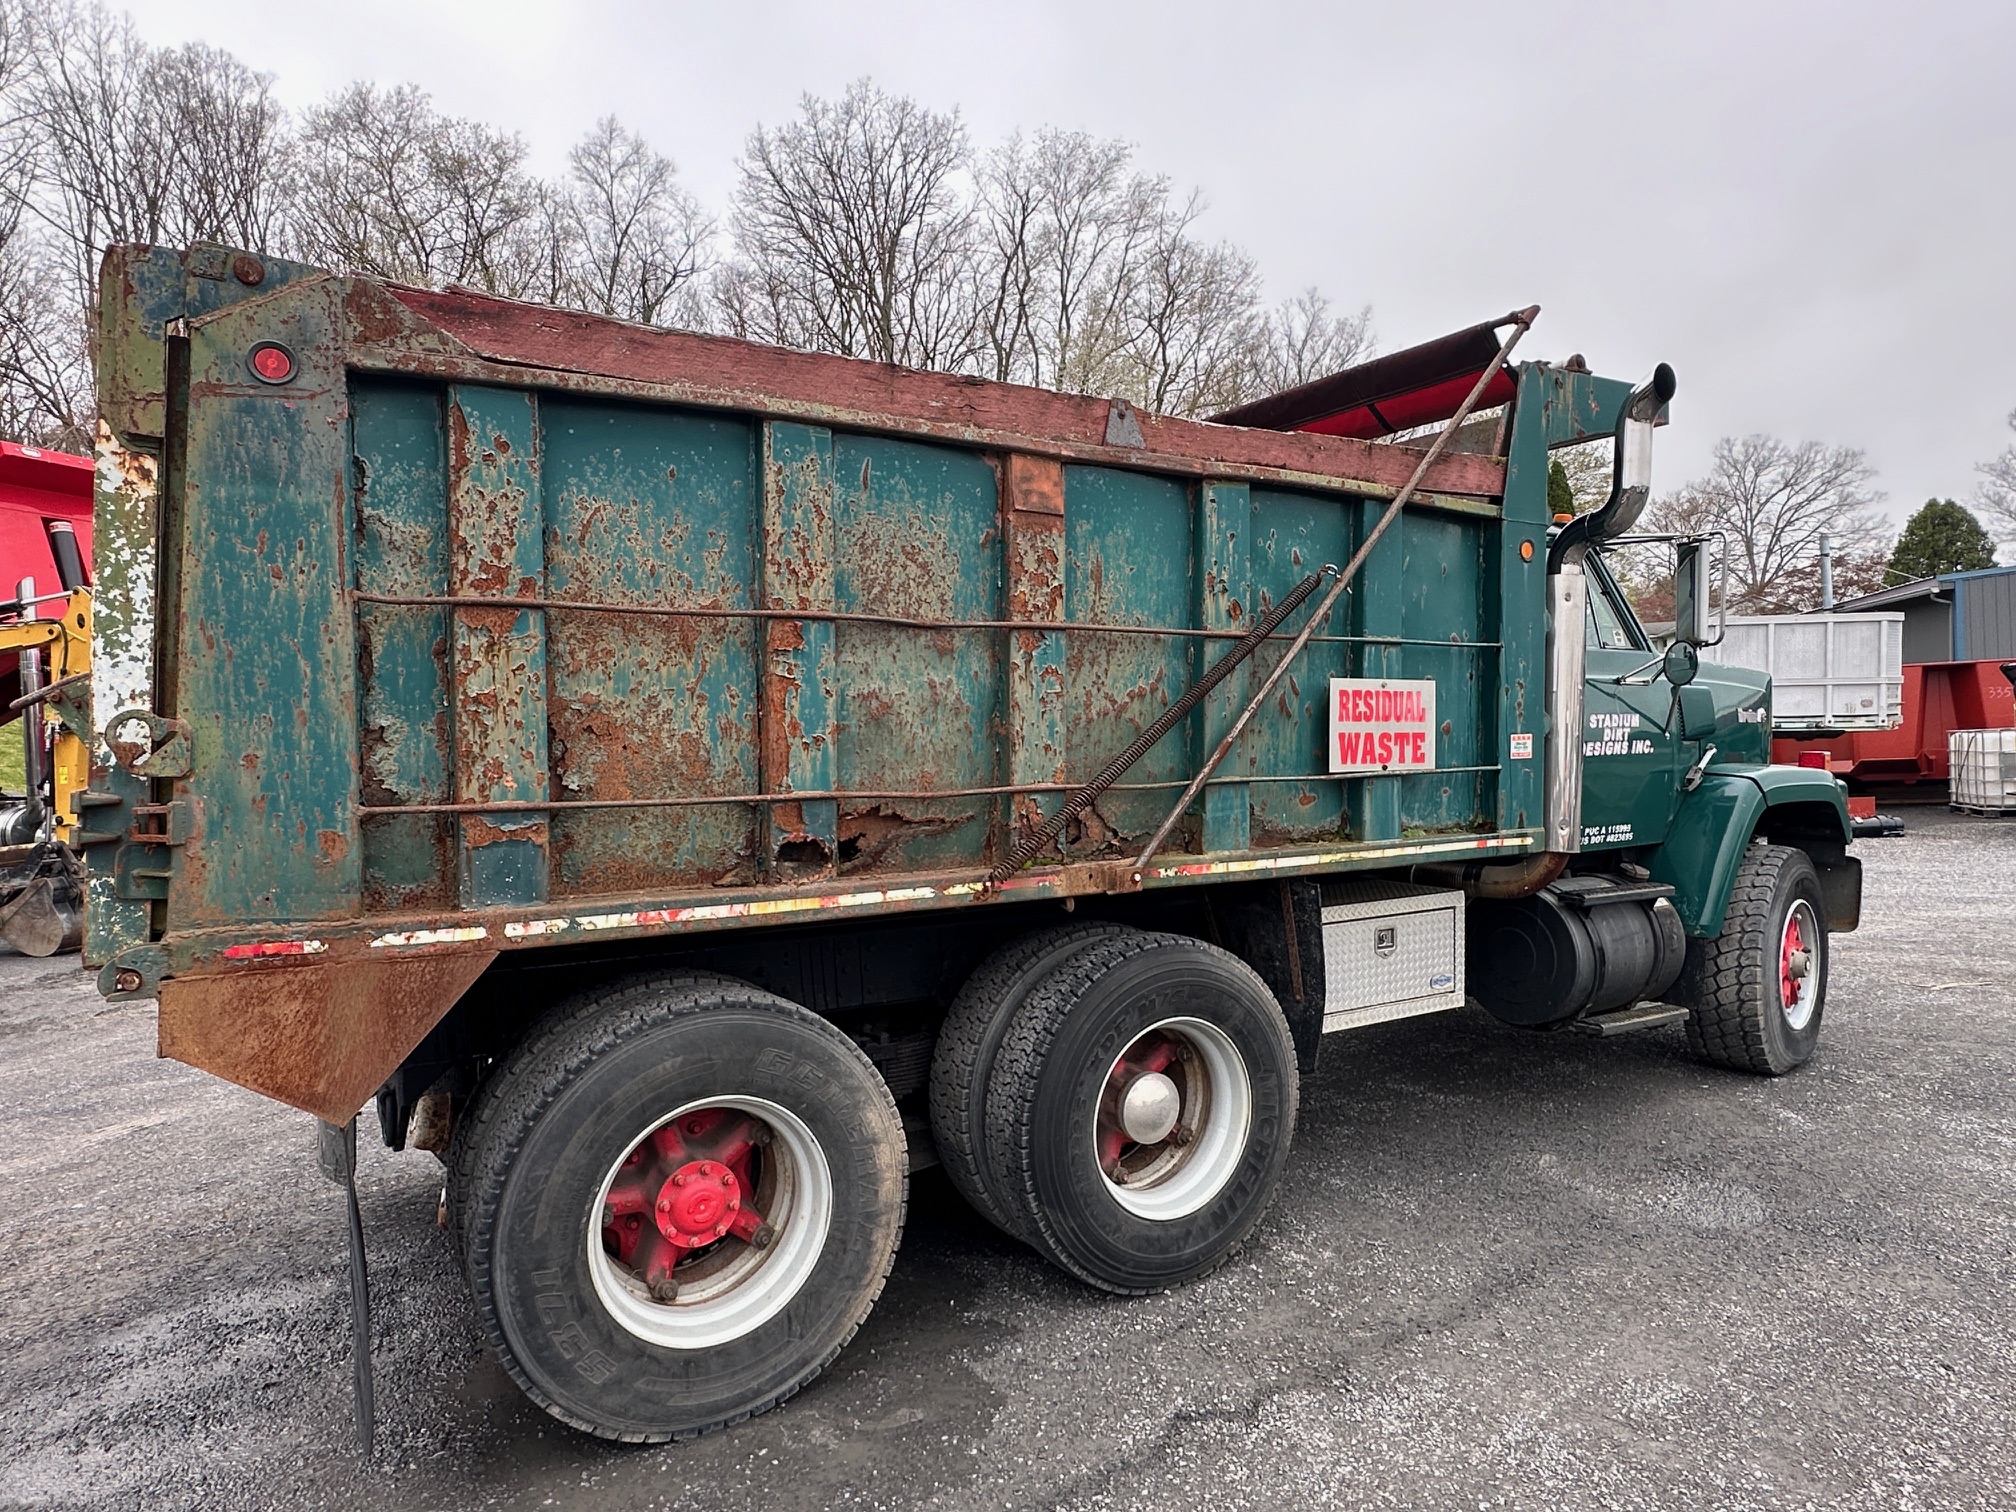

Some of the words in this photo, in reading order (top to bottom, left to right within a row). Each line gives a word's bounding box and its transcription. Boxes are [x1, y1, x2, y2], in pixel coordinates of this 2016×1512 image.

[1338, 689, 1426, 723] RESIDUAL
[1589, 713, 1640, 729] STADIUM
[1603, 727, 1631, 741] DIRT
[1338, 732, 1426, 765] WASTE
[1631, 739, 1655, 754] INC.
[1584, 826, 1600, 836] PUC
[1600, 825, 1606, 835] A
[1589, 834, 1606, 845] DOT
[753, 1046, 880, 1253] GENERAL
[1208, 1071, 1279, 1231] MICHELIN
